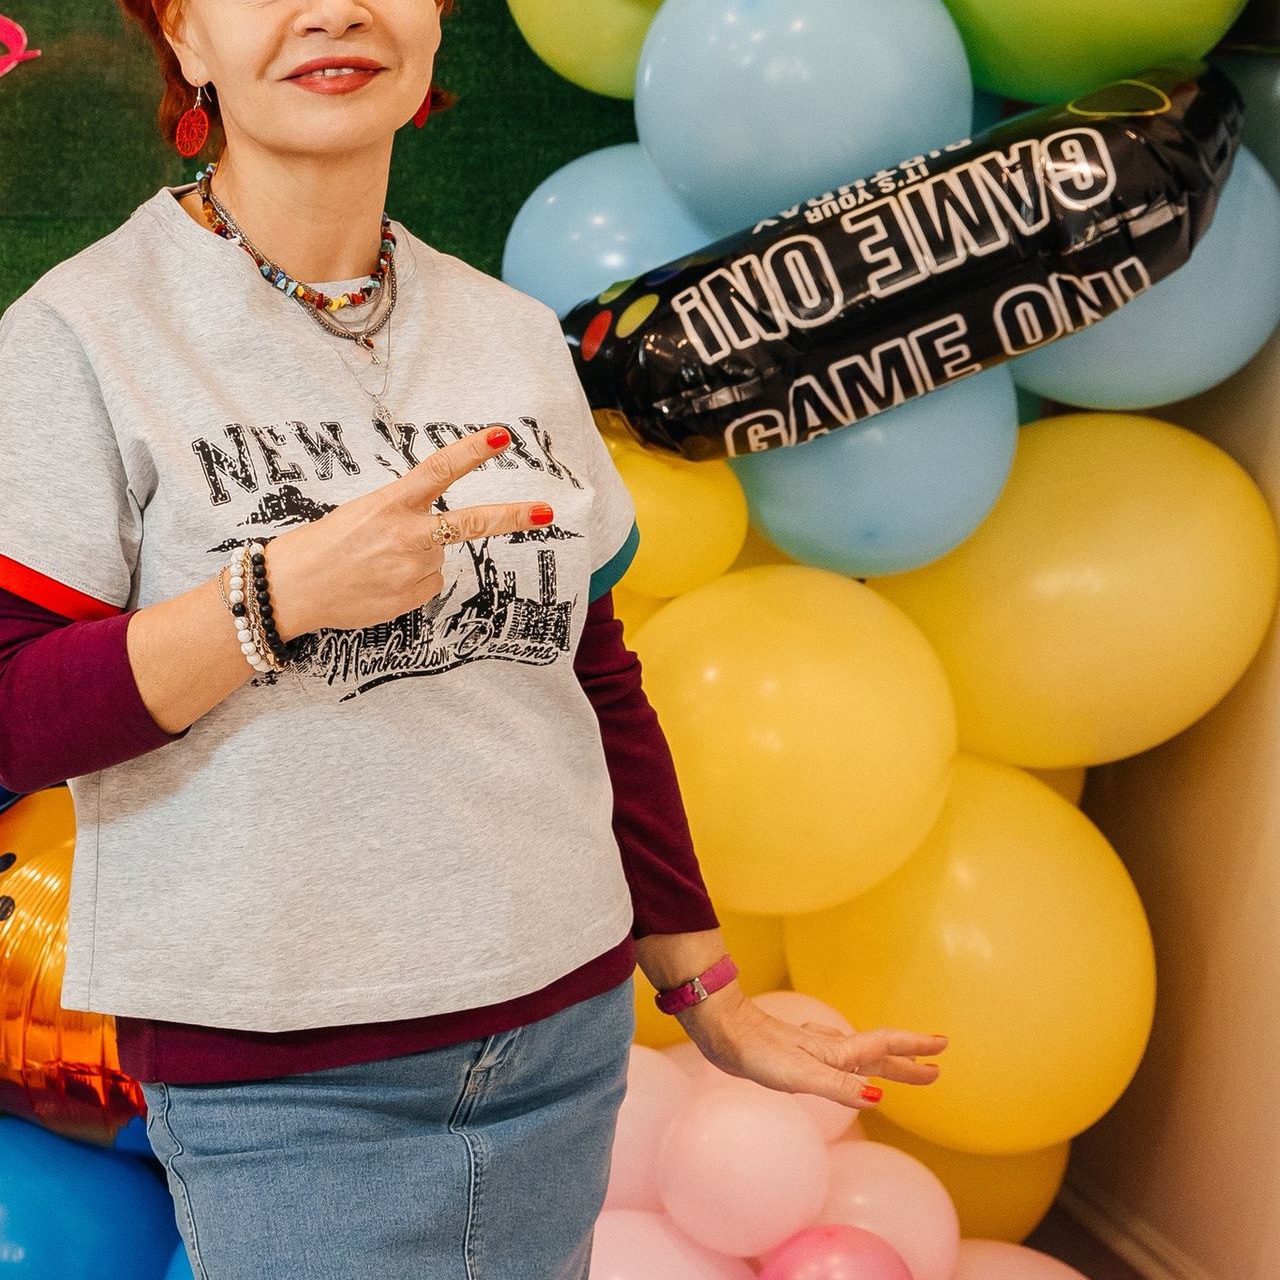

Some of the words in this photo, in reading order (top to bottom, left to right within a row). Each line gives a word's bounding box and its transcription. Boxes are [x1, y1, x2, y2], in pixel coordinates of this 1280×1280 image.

[803, 187, 875, 225] YOUR
[842, 127, 1118, 299] GAME
[876, 161, 930, 194] IT'S
[671, 234, 845, 366] ON!
[724, 313, 982, 458] GAME
[191, 420, 361, 507] NEW
[319, 624, 452, 686] Manhattan
[452, 617, 559, 660] Dreams
